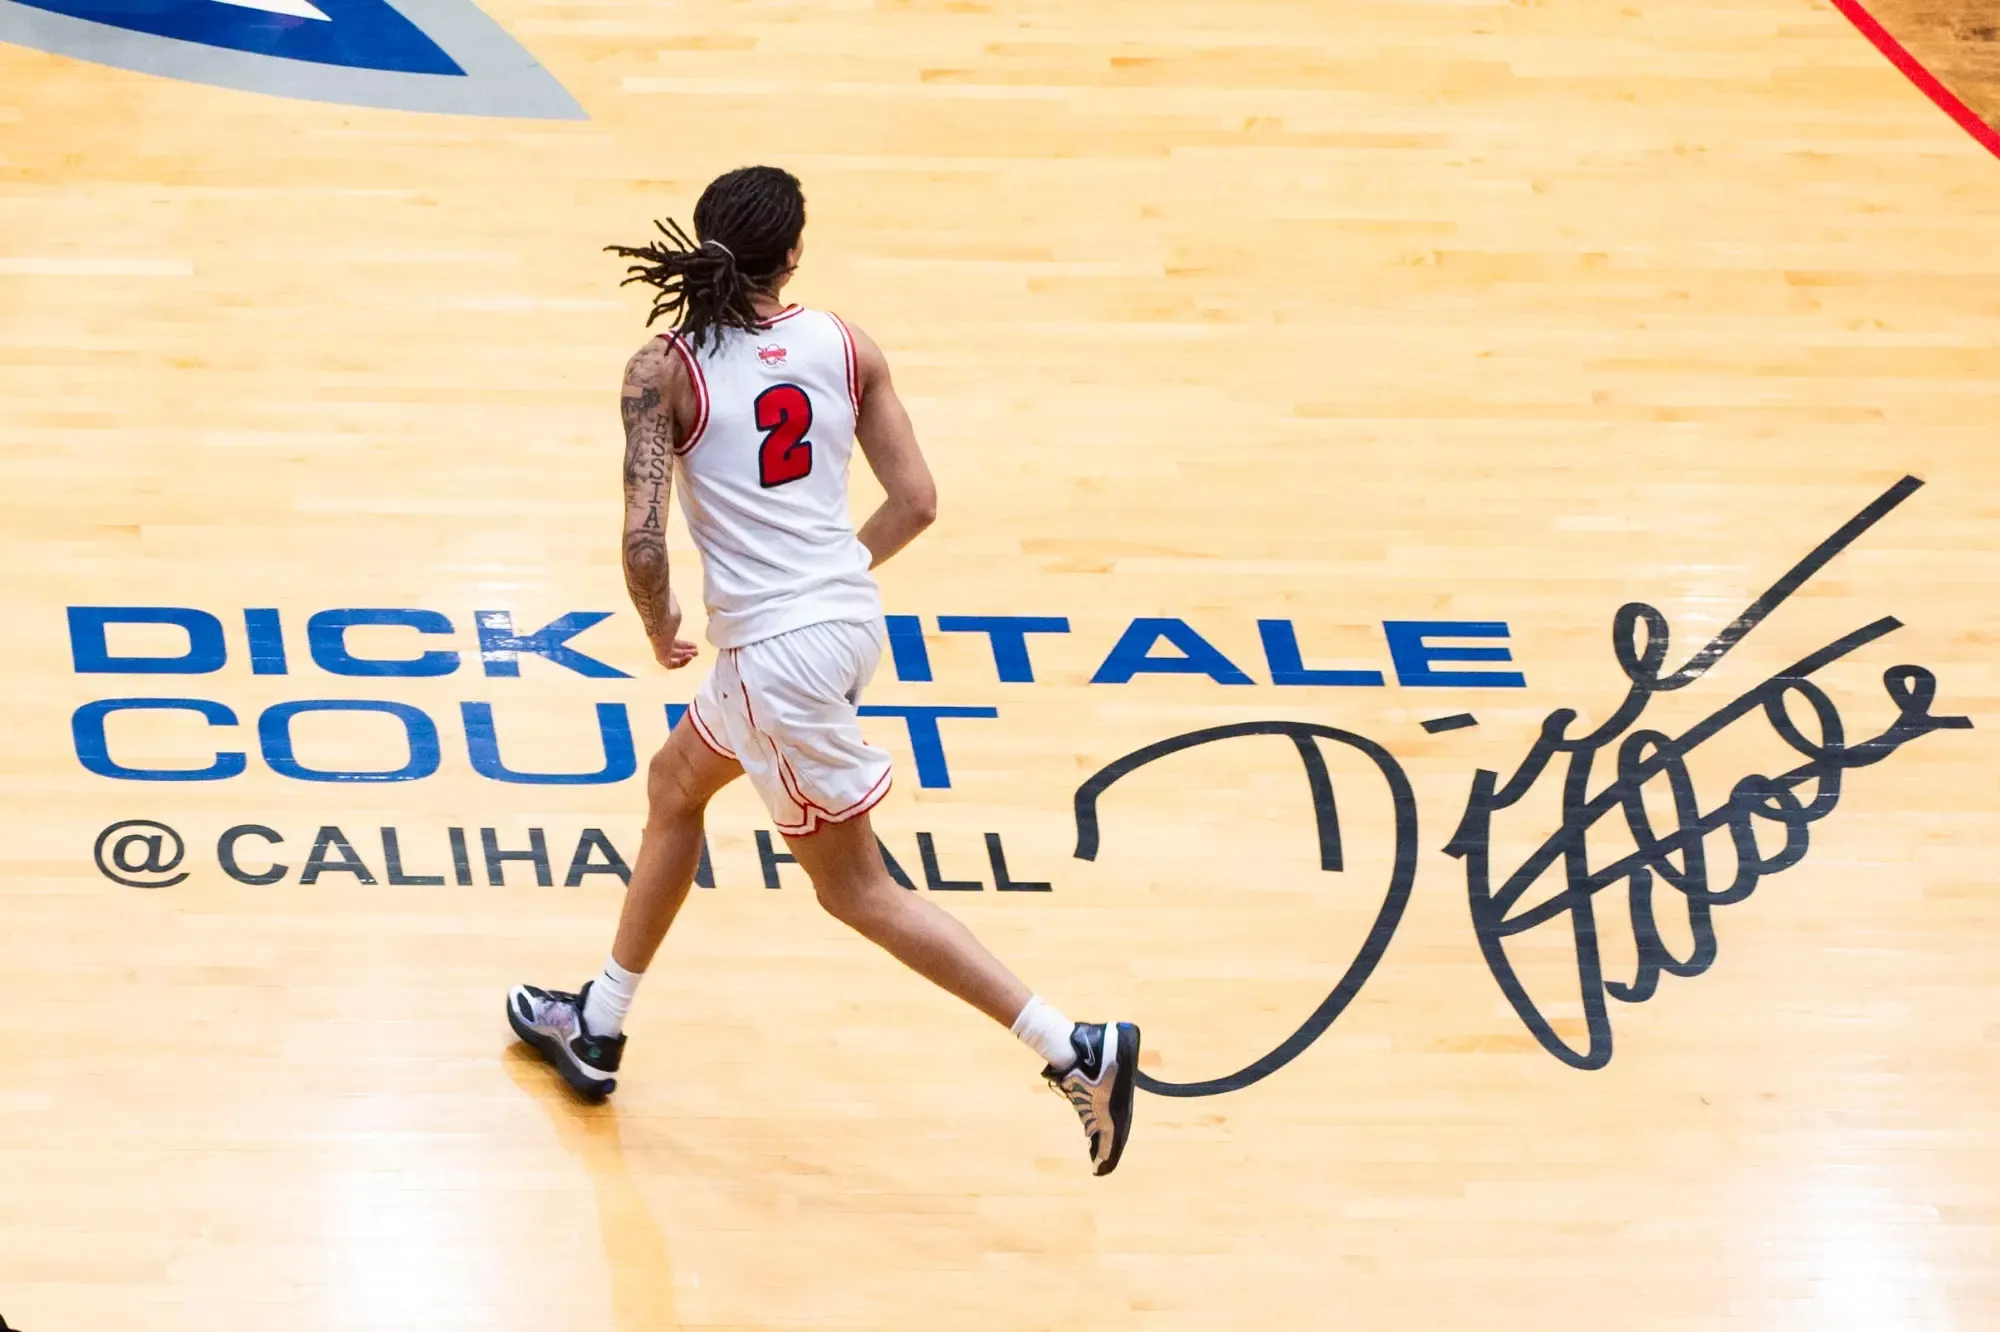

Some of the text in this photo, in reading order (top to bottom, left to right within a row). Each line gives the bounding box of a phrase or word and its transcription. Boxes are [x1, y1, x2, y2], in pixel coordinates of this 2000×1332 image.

[754, 383, 813, 489] 2
[65, 605, 1527, 689] DICK ITALE
[70, 697, 998, 789] COUT
[93, 819, 191, 889] @
